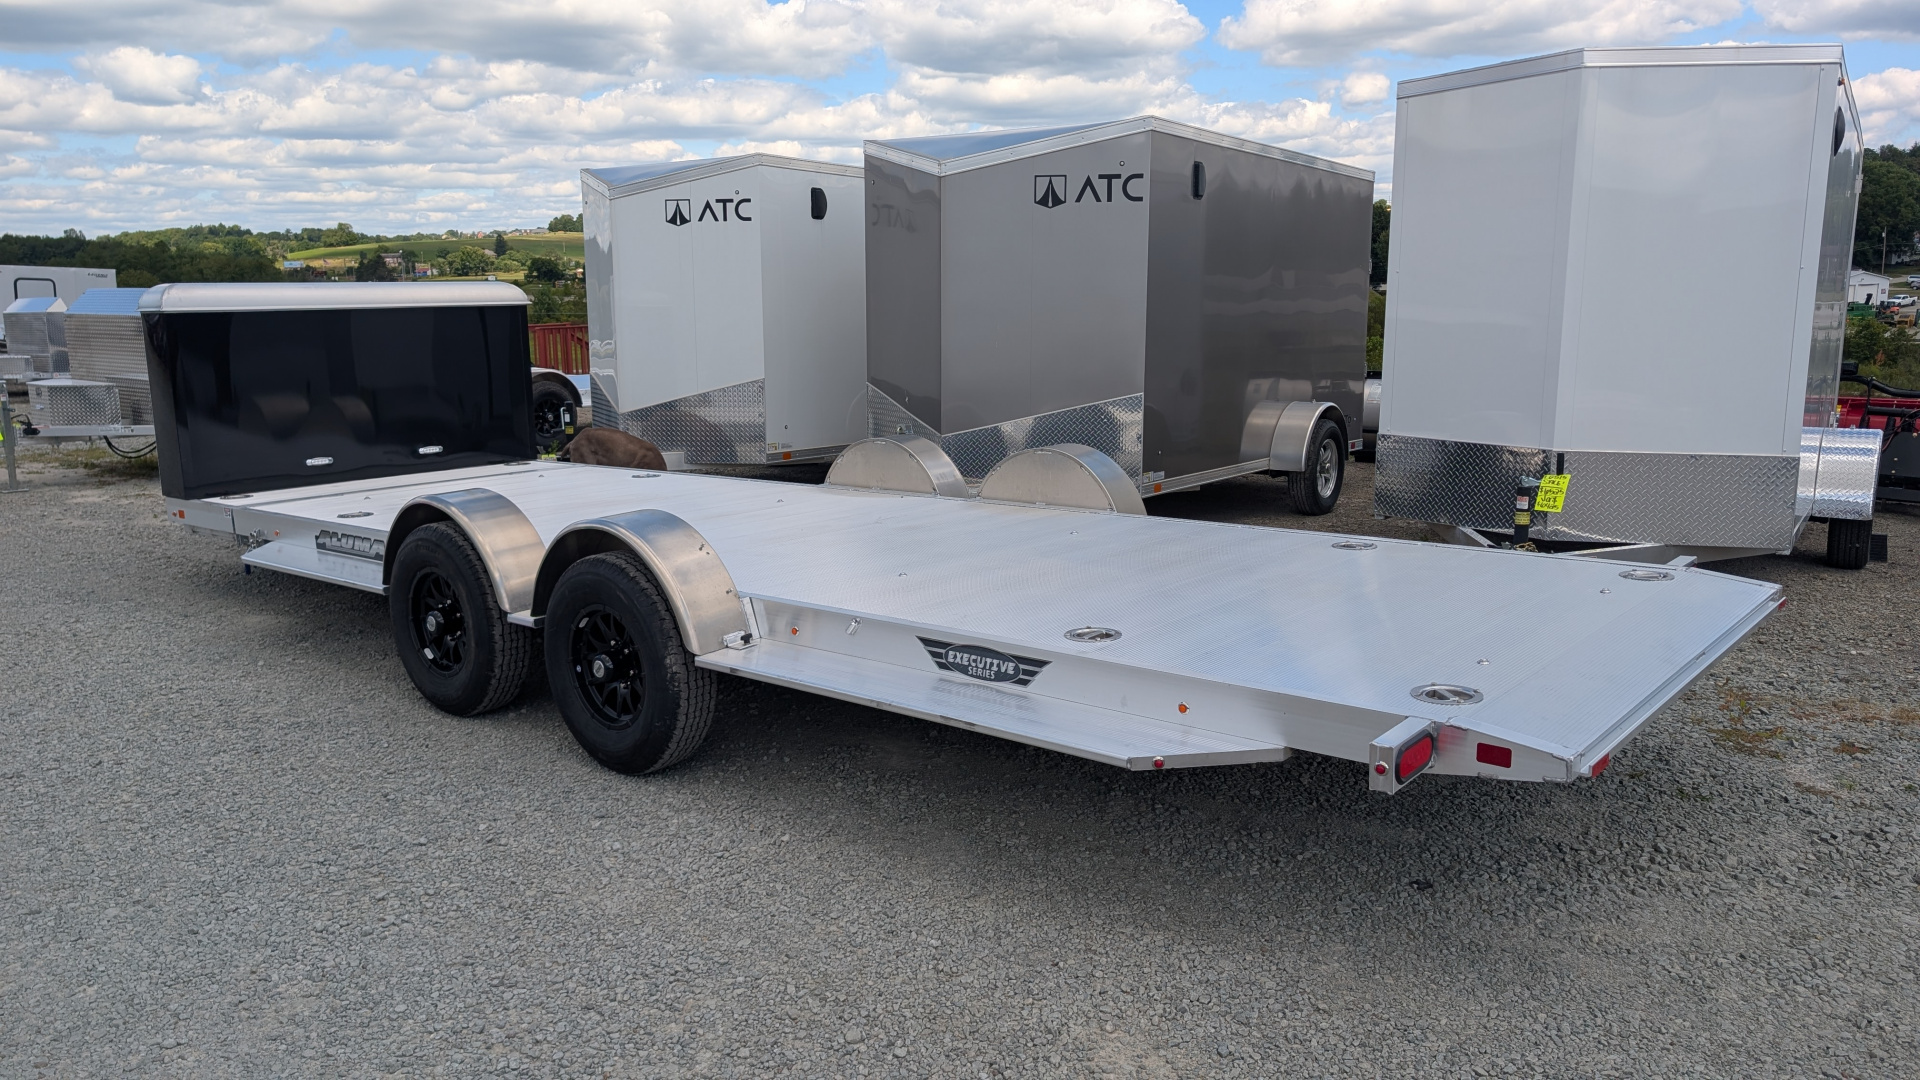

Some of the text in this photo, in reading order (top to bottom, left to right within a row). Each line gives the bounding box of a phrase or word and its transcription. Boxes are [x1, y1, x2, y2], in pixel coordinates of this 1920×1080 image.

[1074, 173, 1144, 203] ATC
[698, 198, 752, 222] ATC
[316, 530, 386, 558] ALUMA
[947, 650, 1016, 675] EXECUTIVE
[967, 666, 996, 679] SERIES
